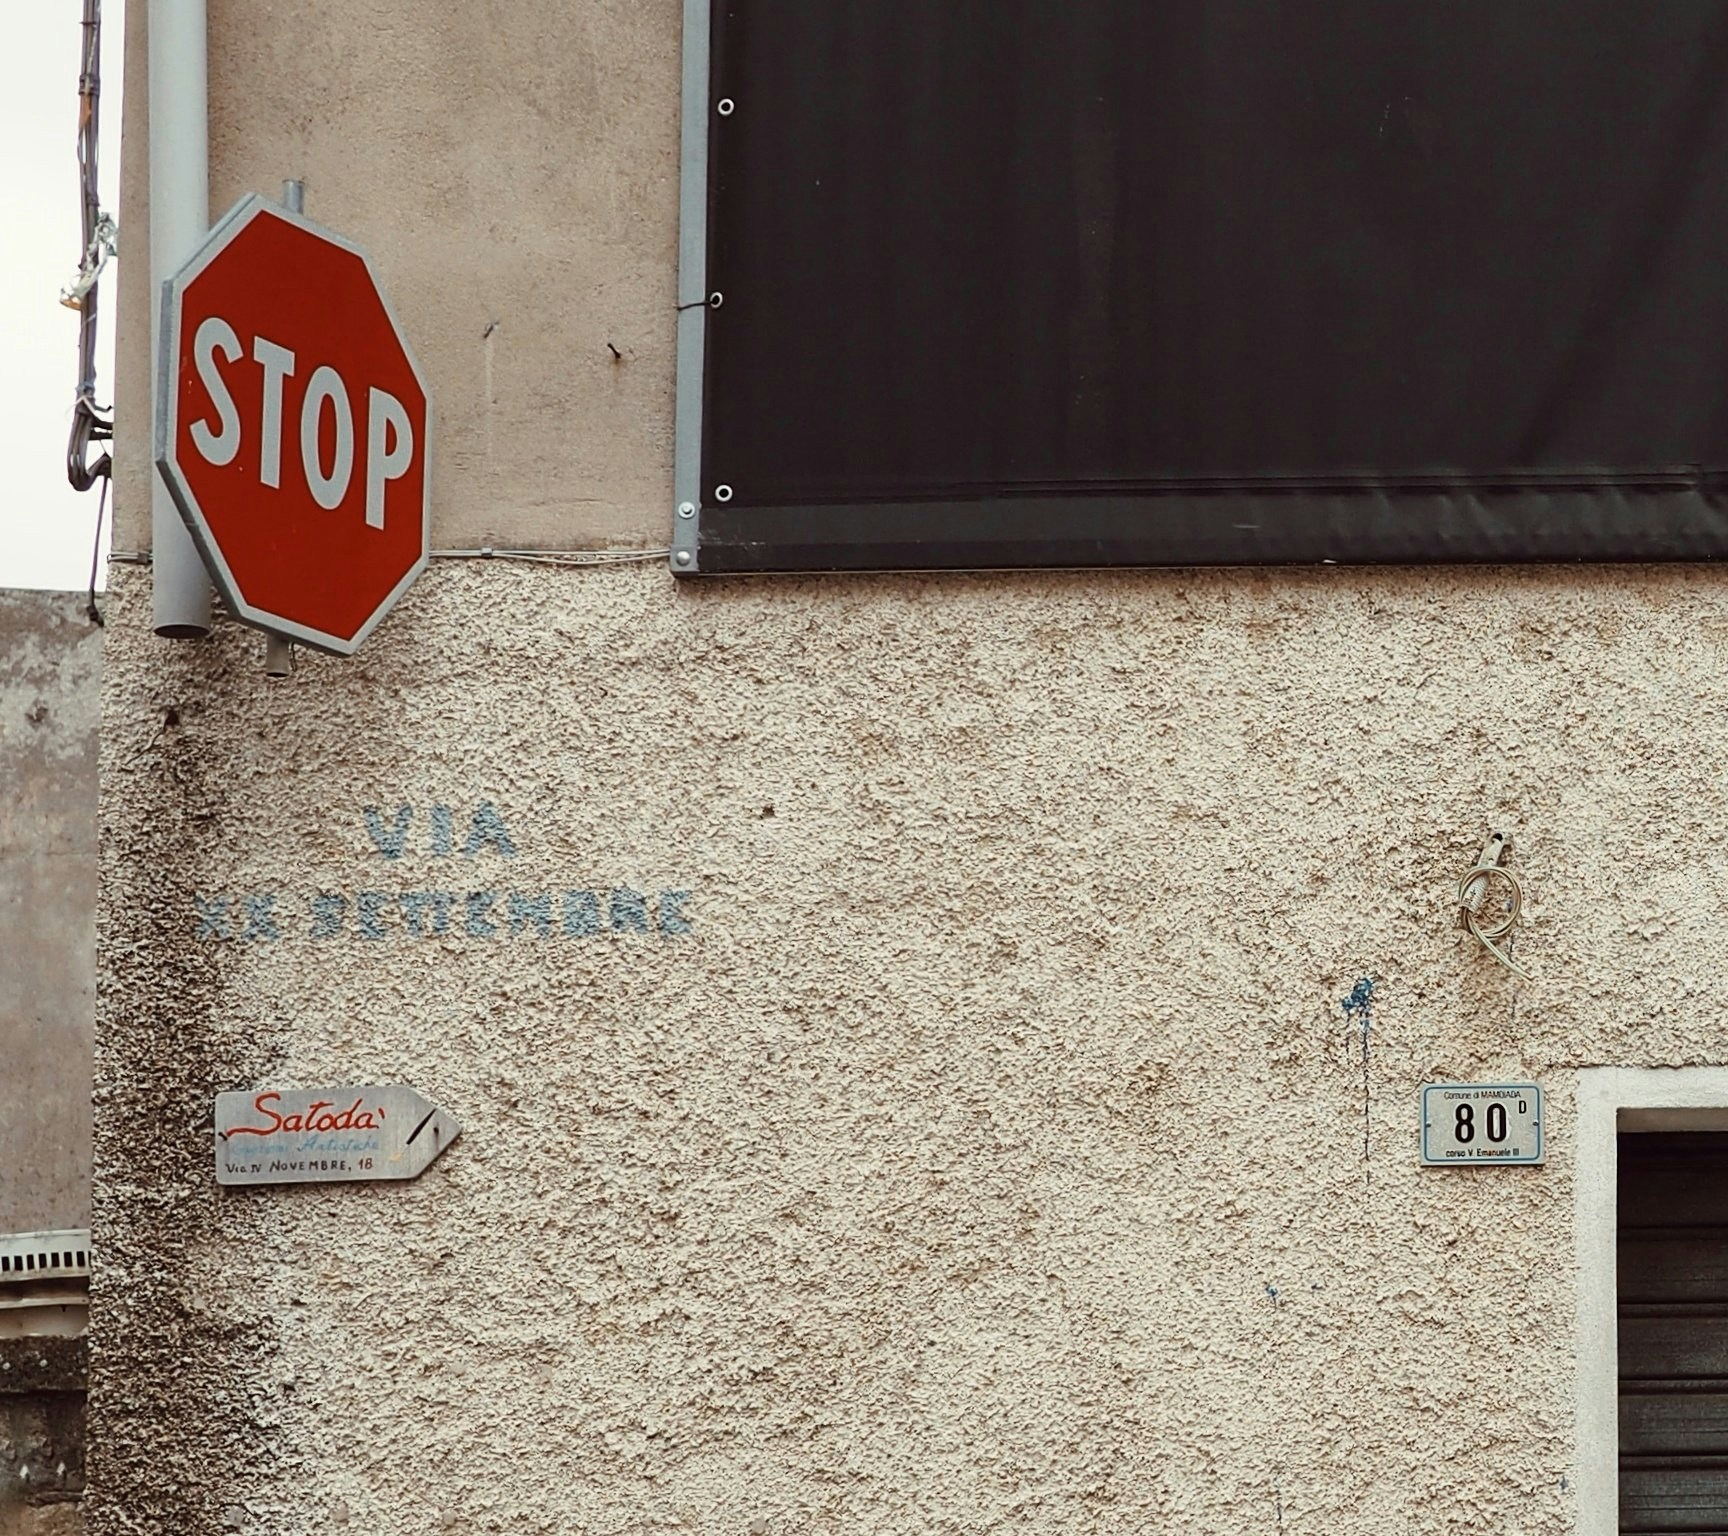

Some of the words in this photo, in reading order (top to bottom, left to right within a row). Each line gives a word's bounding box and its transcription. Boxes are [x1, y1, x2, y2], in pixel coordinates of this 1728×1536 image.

[189, 317, 414, 531] STOP
[362, 800, 517, 860] VIA
[307, 887, 694, 940] SETTEMBRE
[1443, 1091, 1472, 1100] Comune
[1455, 1103, 1507, 1143] 80
[1518, 1100, 1527, 1114] D
[225, 1163, 247, 1173] Via
[269, 1159, 352, 1173] NOVEMBRE,
[358, 1157, 373, 1170] 18
[1445, 1149, 1466, 1158] corso
[1476, 1147, 1511, 1157] Emanuele
